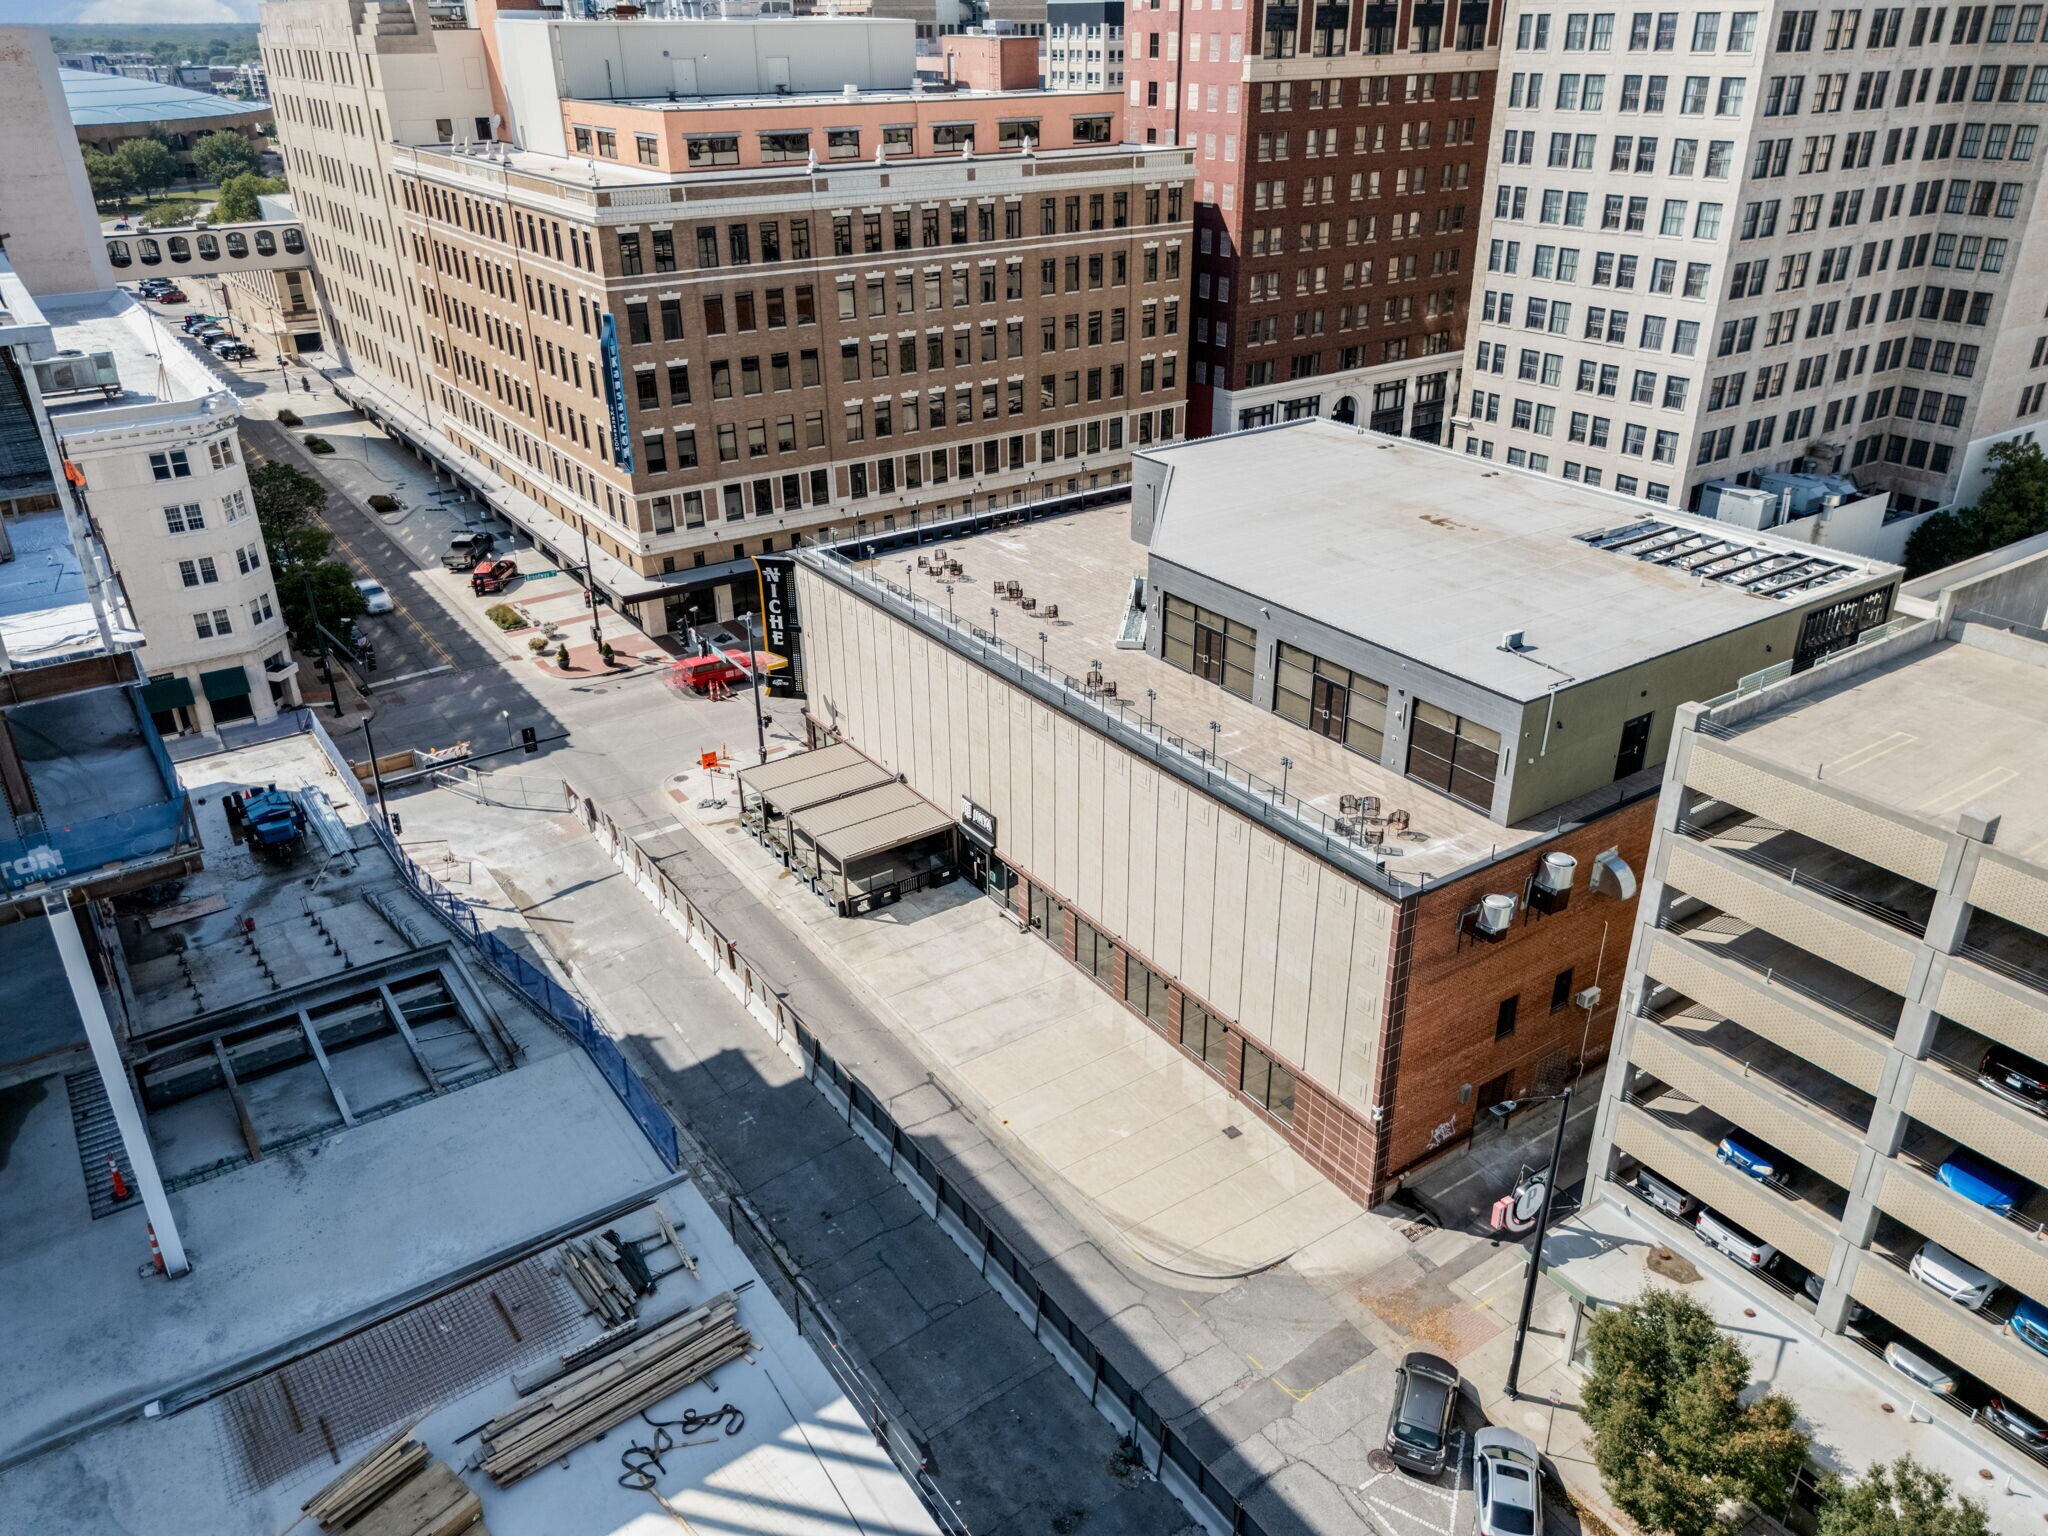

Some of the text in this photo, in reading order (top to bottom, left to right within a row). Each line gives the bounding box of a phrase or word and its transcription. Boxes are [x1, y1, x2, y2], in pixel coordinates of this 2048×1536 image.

[762, 567, 784, 646] NICHE
[13, 868, 67, 887] BUILD
[1526, 1188, 1538, 1209] P
